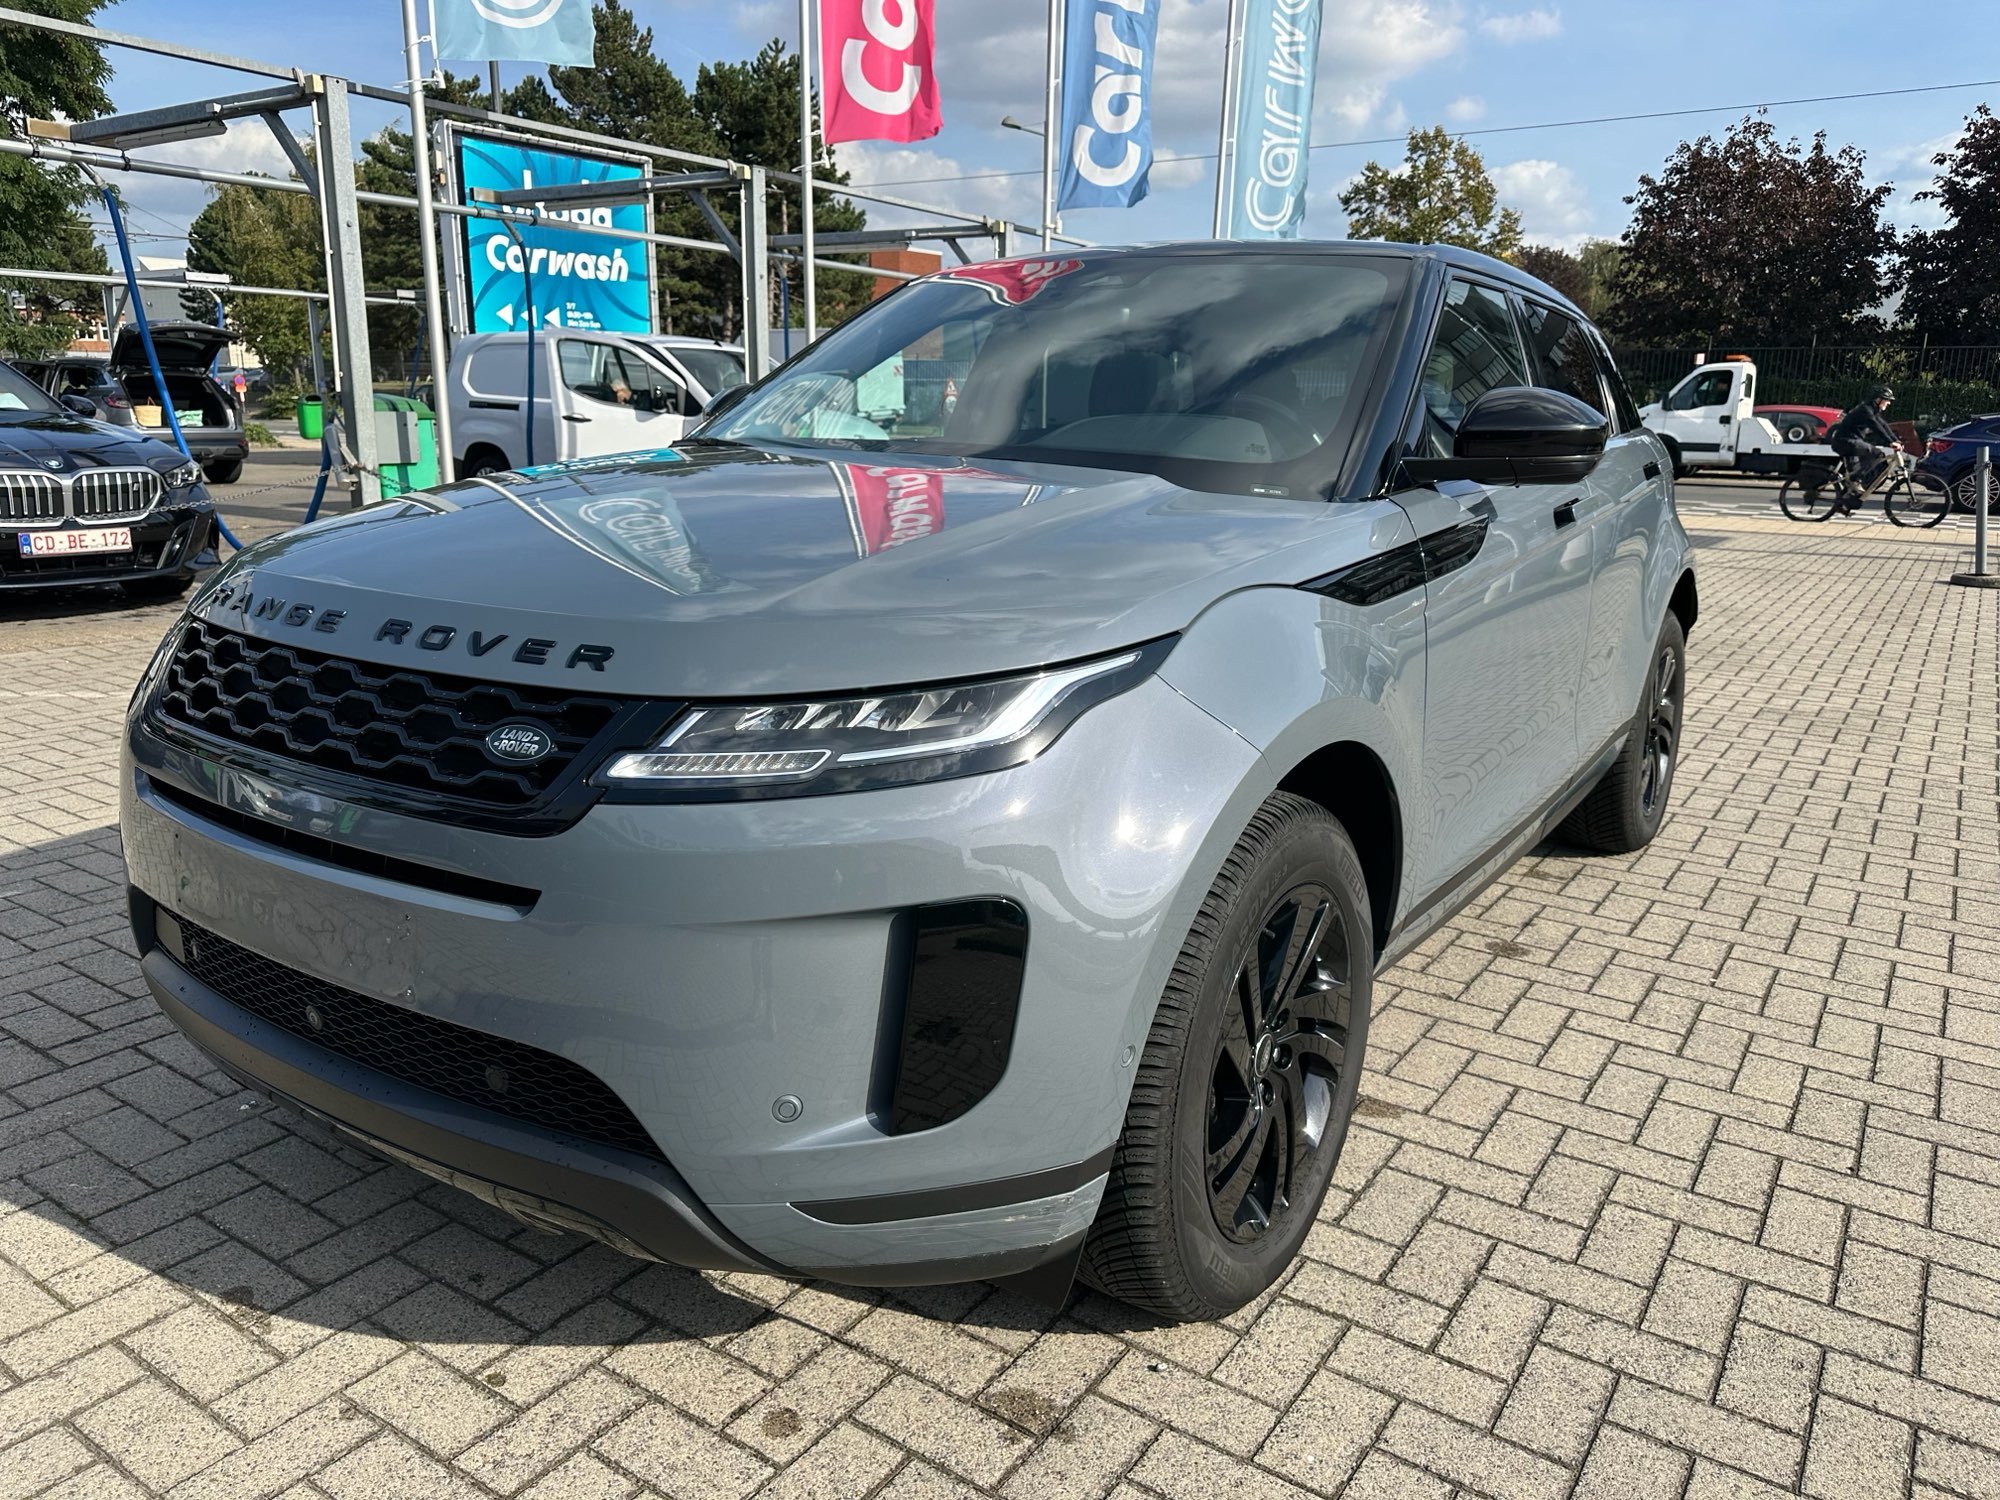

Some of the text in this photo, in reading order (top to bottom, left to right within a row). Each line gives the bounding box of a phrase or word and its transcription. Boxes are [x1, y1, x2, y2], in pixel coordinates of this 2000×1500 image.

[1072, 0, 1145, 187] Car
[1245, 0, 1310, 232] Carw
[486, 234, 629, 283] Carwash
[211, 585, 616, 672] RANGE ROVER
[498, 739, 538, 755] ROVER
[500, 728, 534, 742] LAND
